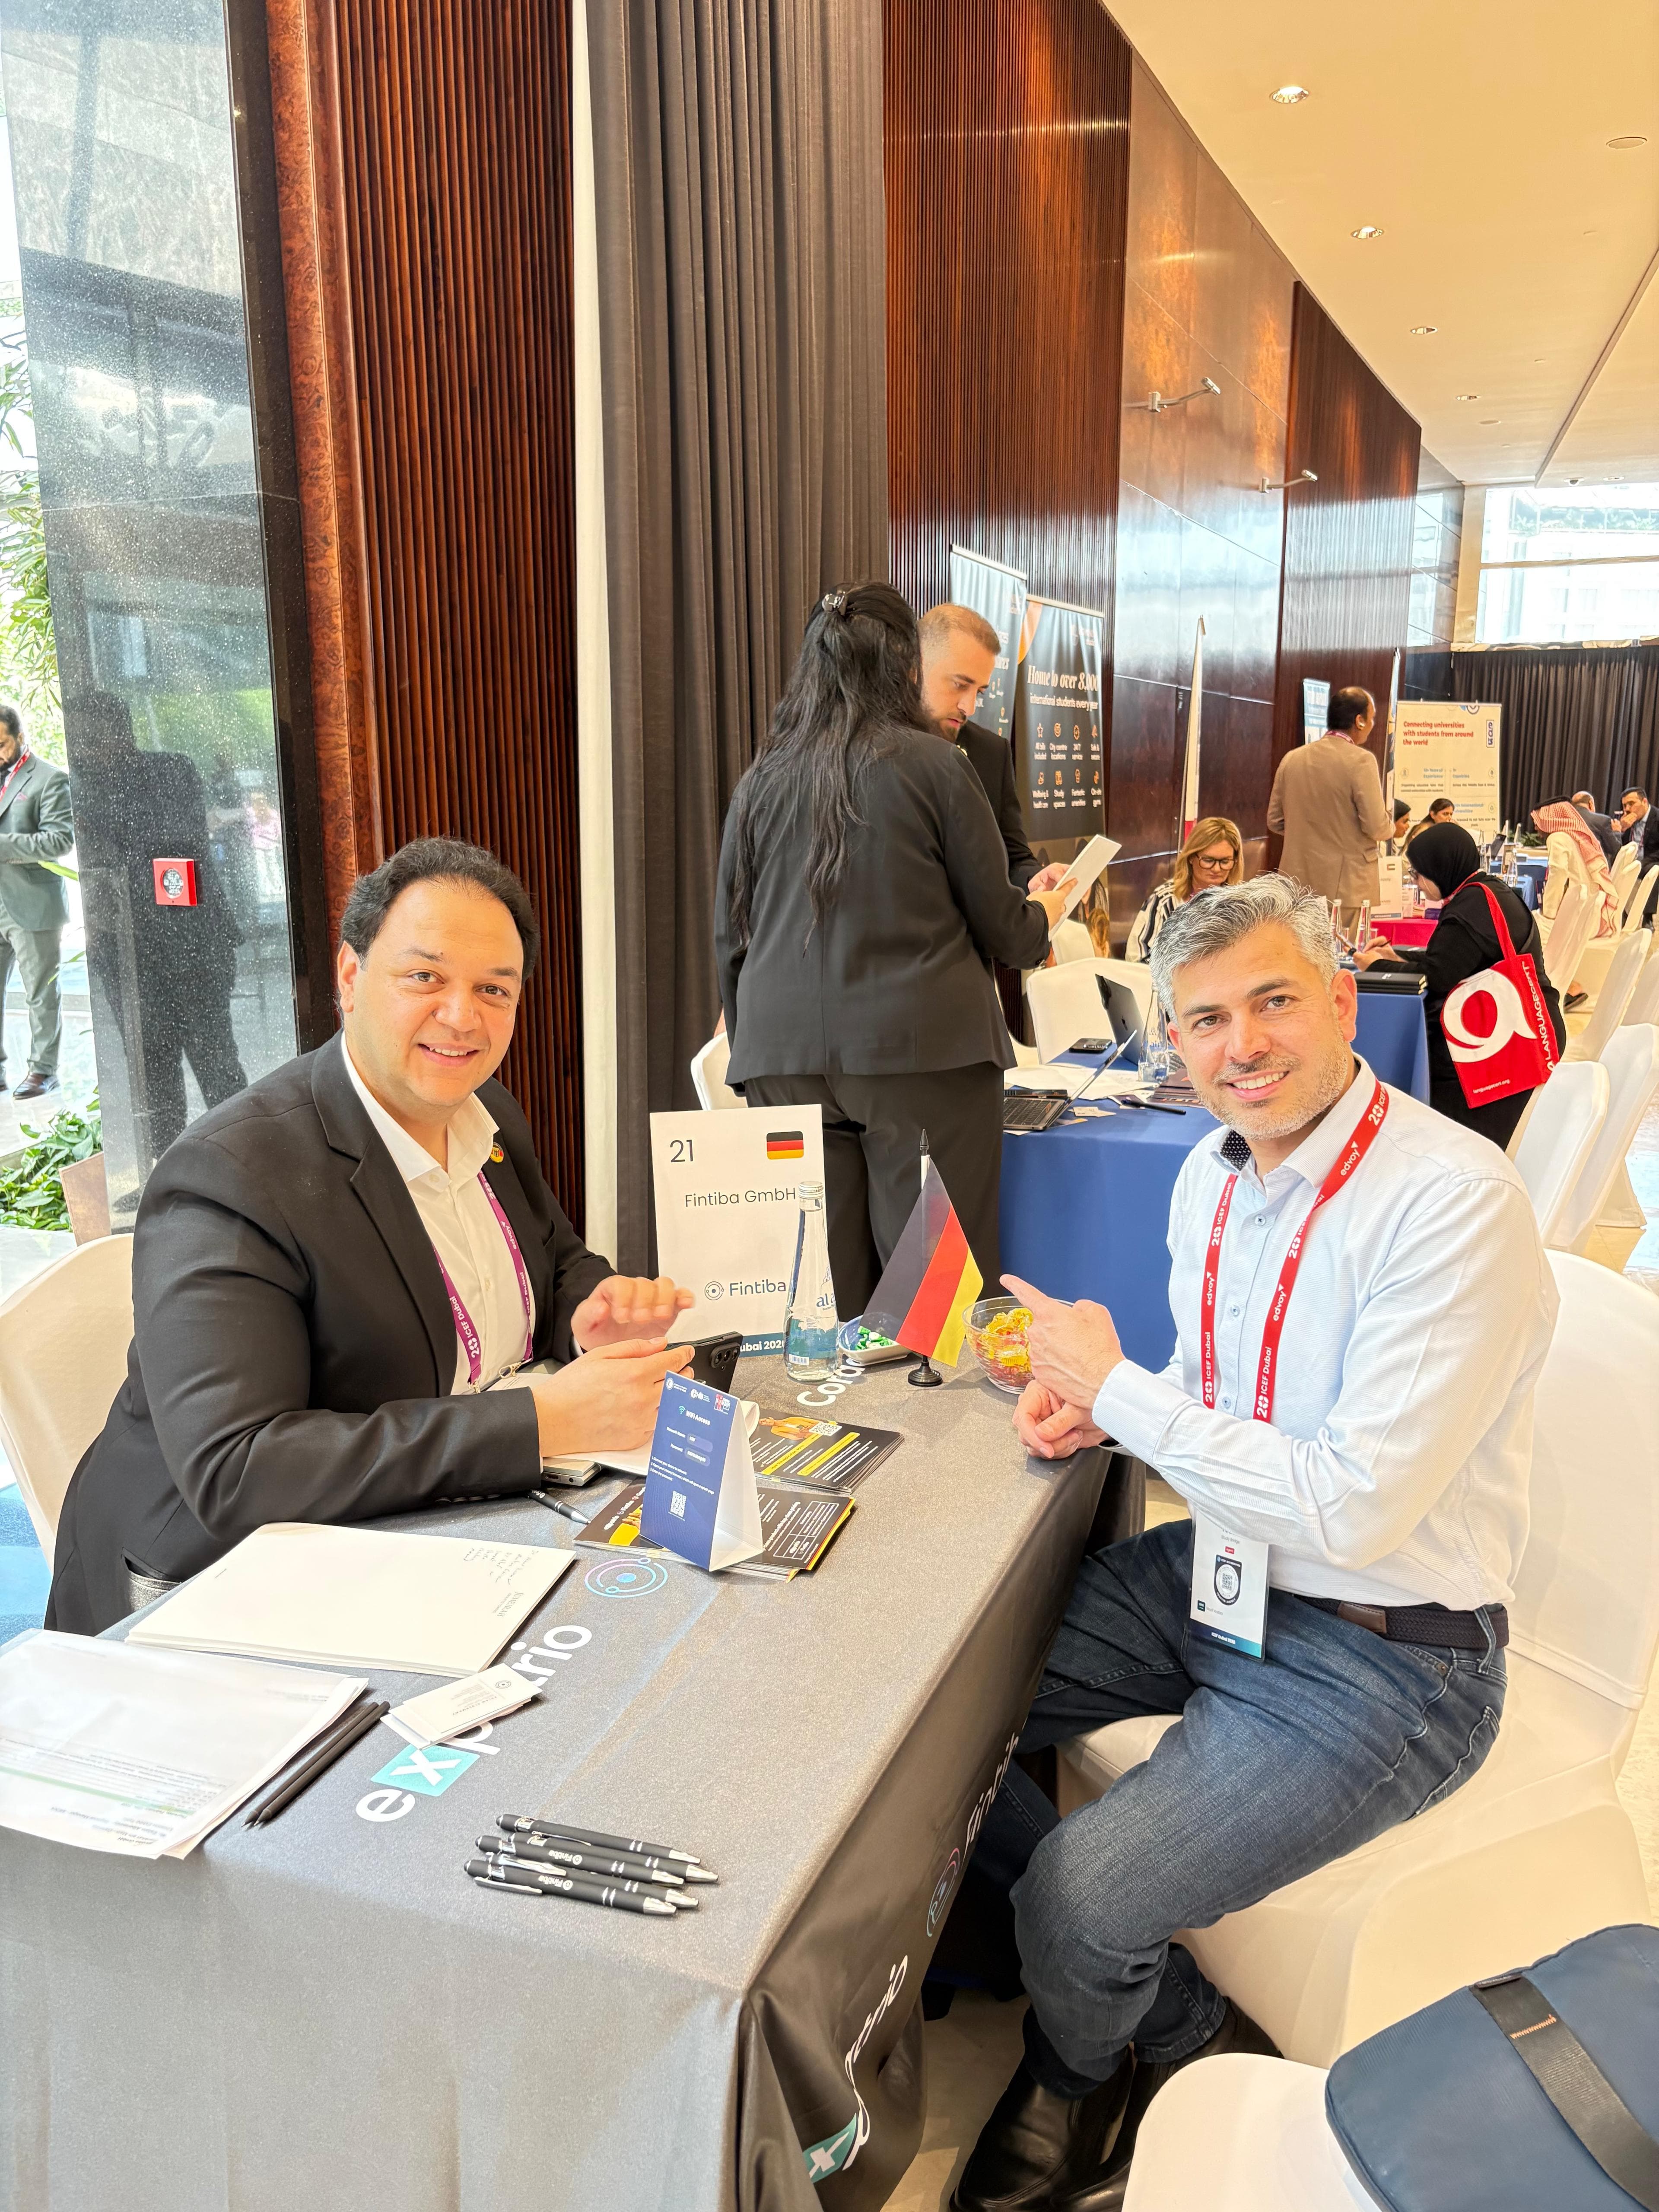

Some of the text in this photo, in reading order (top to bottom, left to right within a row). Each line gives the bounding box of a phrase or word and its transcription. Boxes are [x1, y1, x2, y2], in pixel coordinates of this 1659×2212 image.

[1027, 665, 1050, 686] Home
[1051, 671, 1058, 687] to
[1060, 674, 1077, 689] over
[1056, 696, 1075, 708] students
[670, 1140, 693, 1162] 21
[1341, 1148, 1360, 1176] edvoy
[685, 1188, 796, 1207] Fintiba GmbH
[1222, 1182, 1232, 1207] Dubai
[505, 1225, 517, 1250] edvoy
[730, 1279, 786, 1296] Fintiba
[450, 1296, 465, 1320] Dubai
[1273, 1291, 1287, 1321] edvoy
[461, 1321, 473, 1338] ICEF
[740, 1341, 762, 1352] ubai
[1263, 1347, 1272, 1374] Dubai
[695, 1414, 710, 1426] Access
[497, 1592, 524, 1617] JUMEIRAH
[548, 1850, 573, 1862] Fintiba
[538, 1875, 563, 1887] Fintiba
